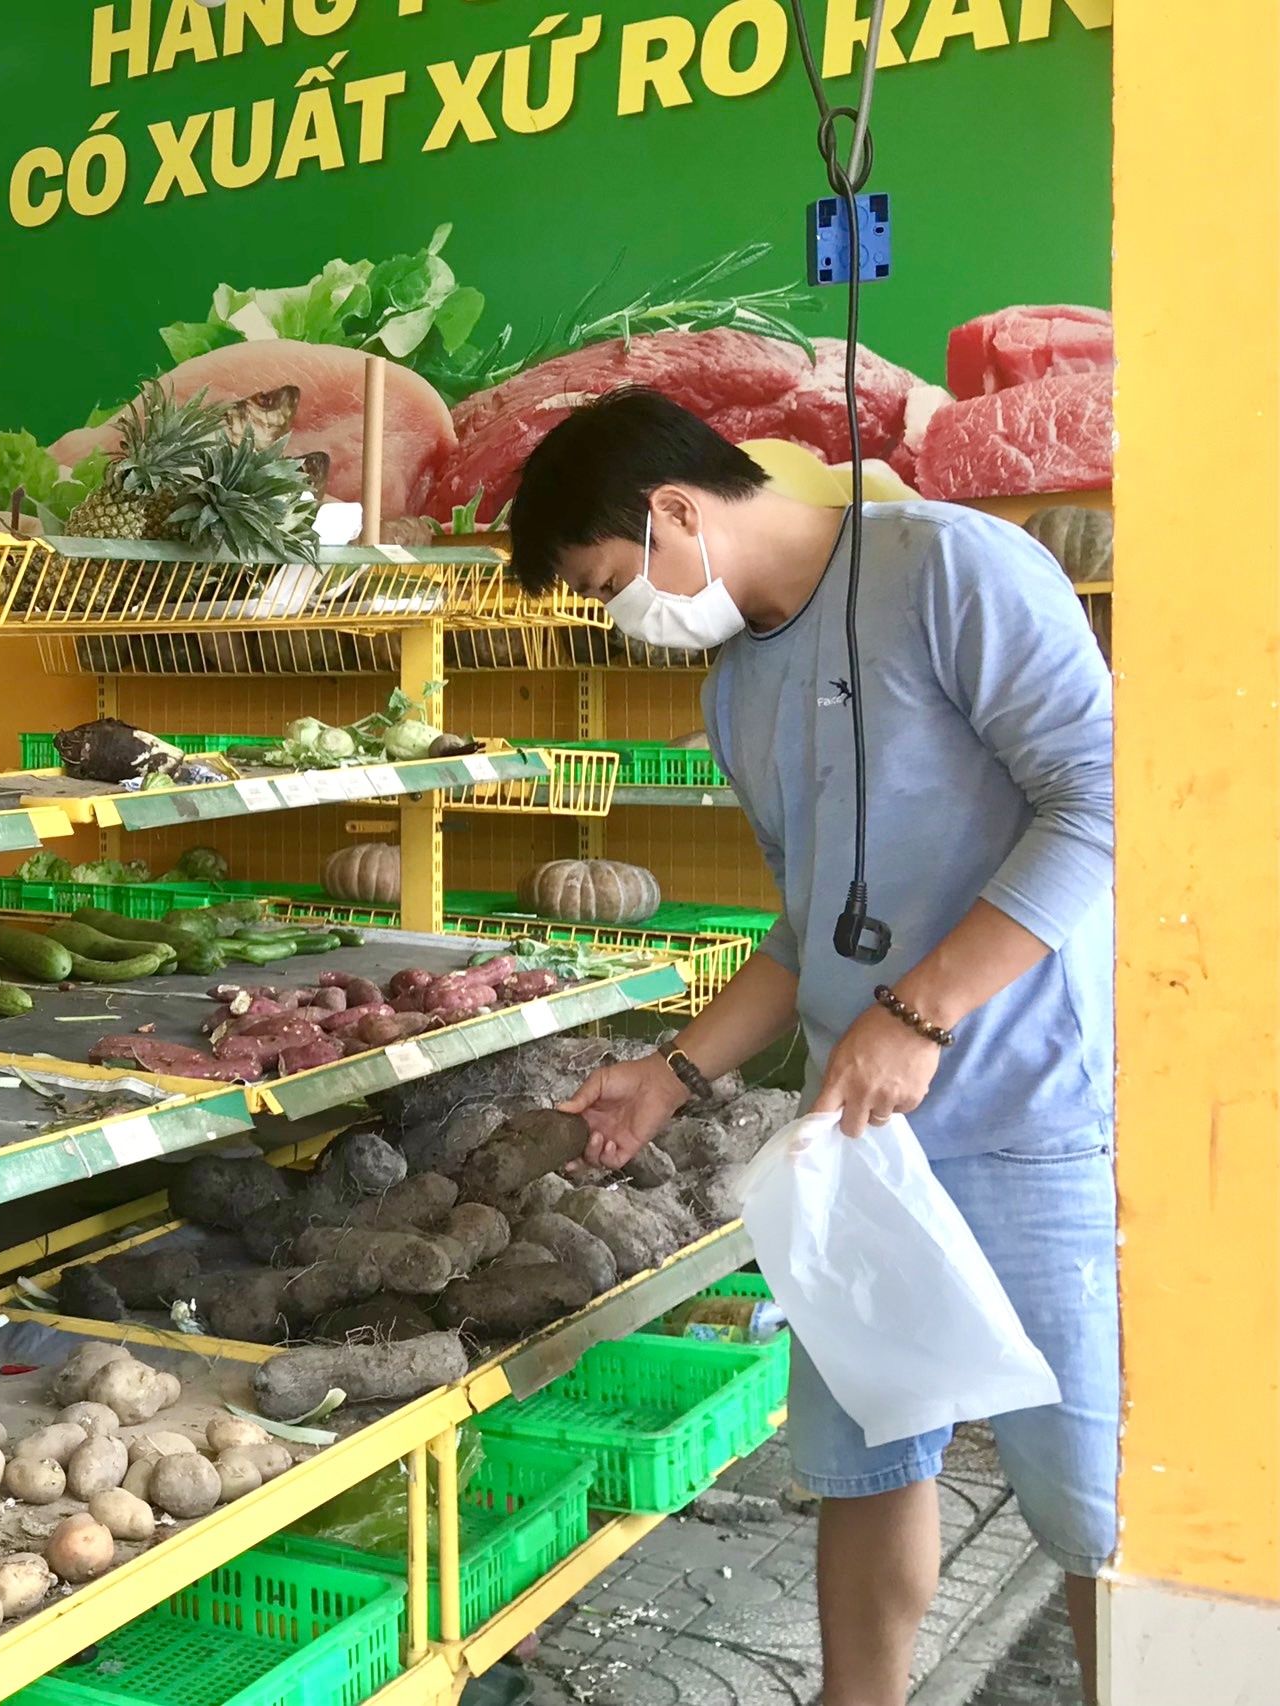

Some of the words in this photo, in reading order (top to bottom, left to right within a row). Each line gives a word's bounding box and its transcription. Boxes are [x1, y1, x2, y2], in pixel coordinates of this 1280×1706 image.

[9, 111, 126, 227] CÓ
[144, 50, 406, 204] XUẤT
[422, 13, 602, 152] XỨ
